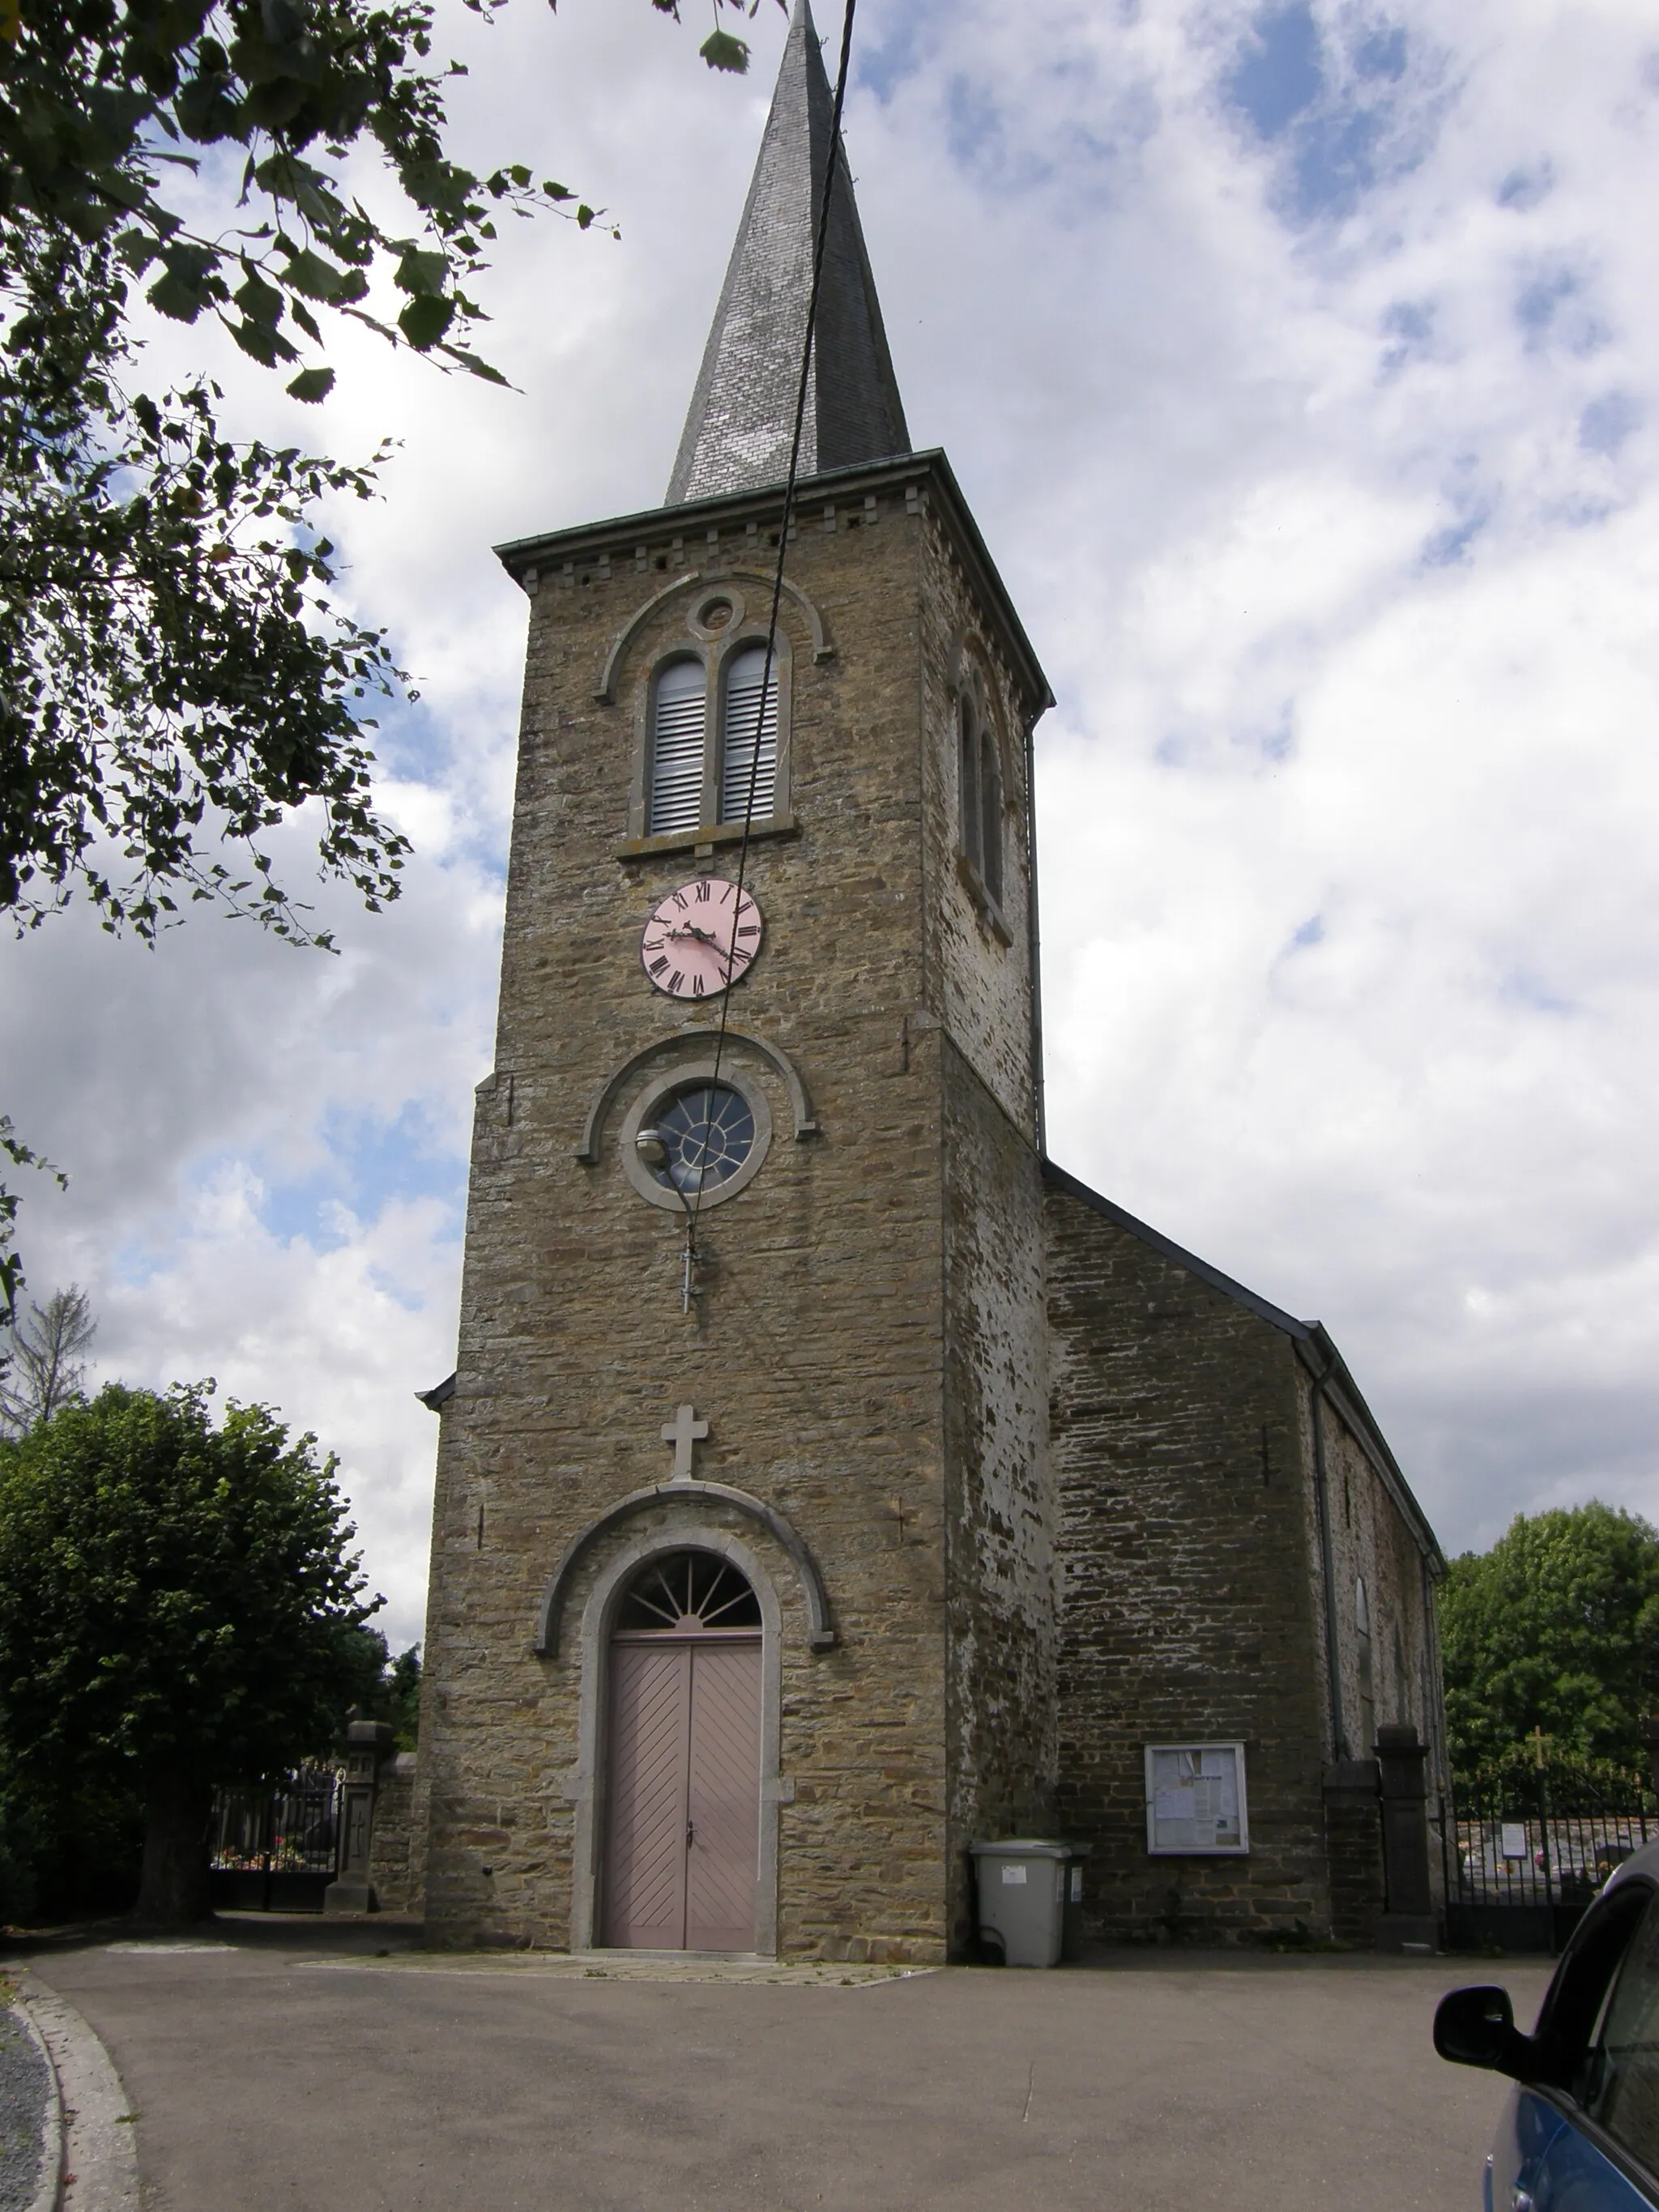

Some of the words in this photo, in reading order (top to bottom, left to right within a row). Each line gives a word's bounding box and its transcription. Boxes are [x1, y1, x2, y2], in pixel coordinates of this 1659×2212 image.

[695, 880, 710, 903] XII
[672, 892, 689, 913] XI
[732, 901, 754, 914] II
[651, 914, 672, 928] X
[738, 926, 761, 938] III
[643, 938, 665, 951] IX
[649, 955, 672, 979] VIII
[667, 970, 685, 994] VII
[693, 974, 705, 997] VI
